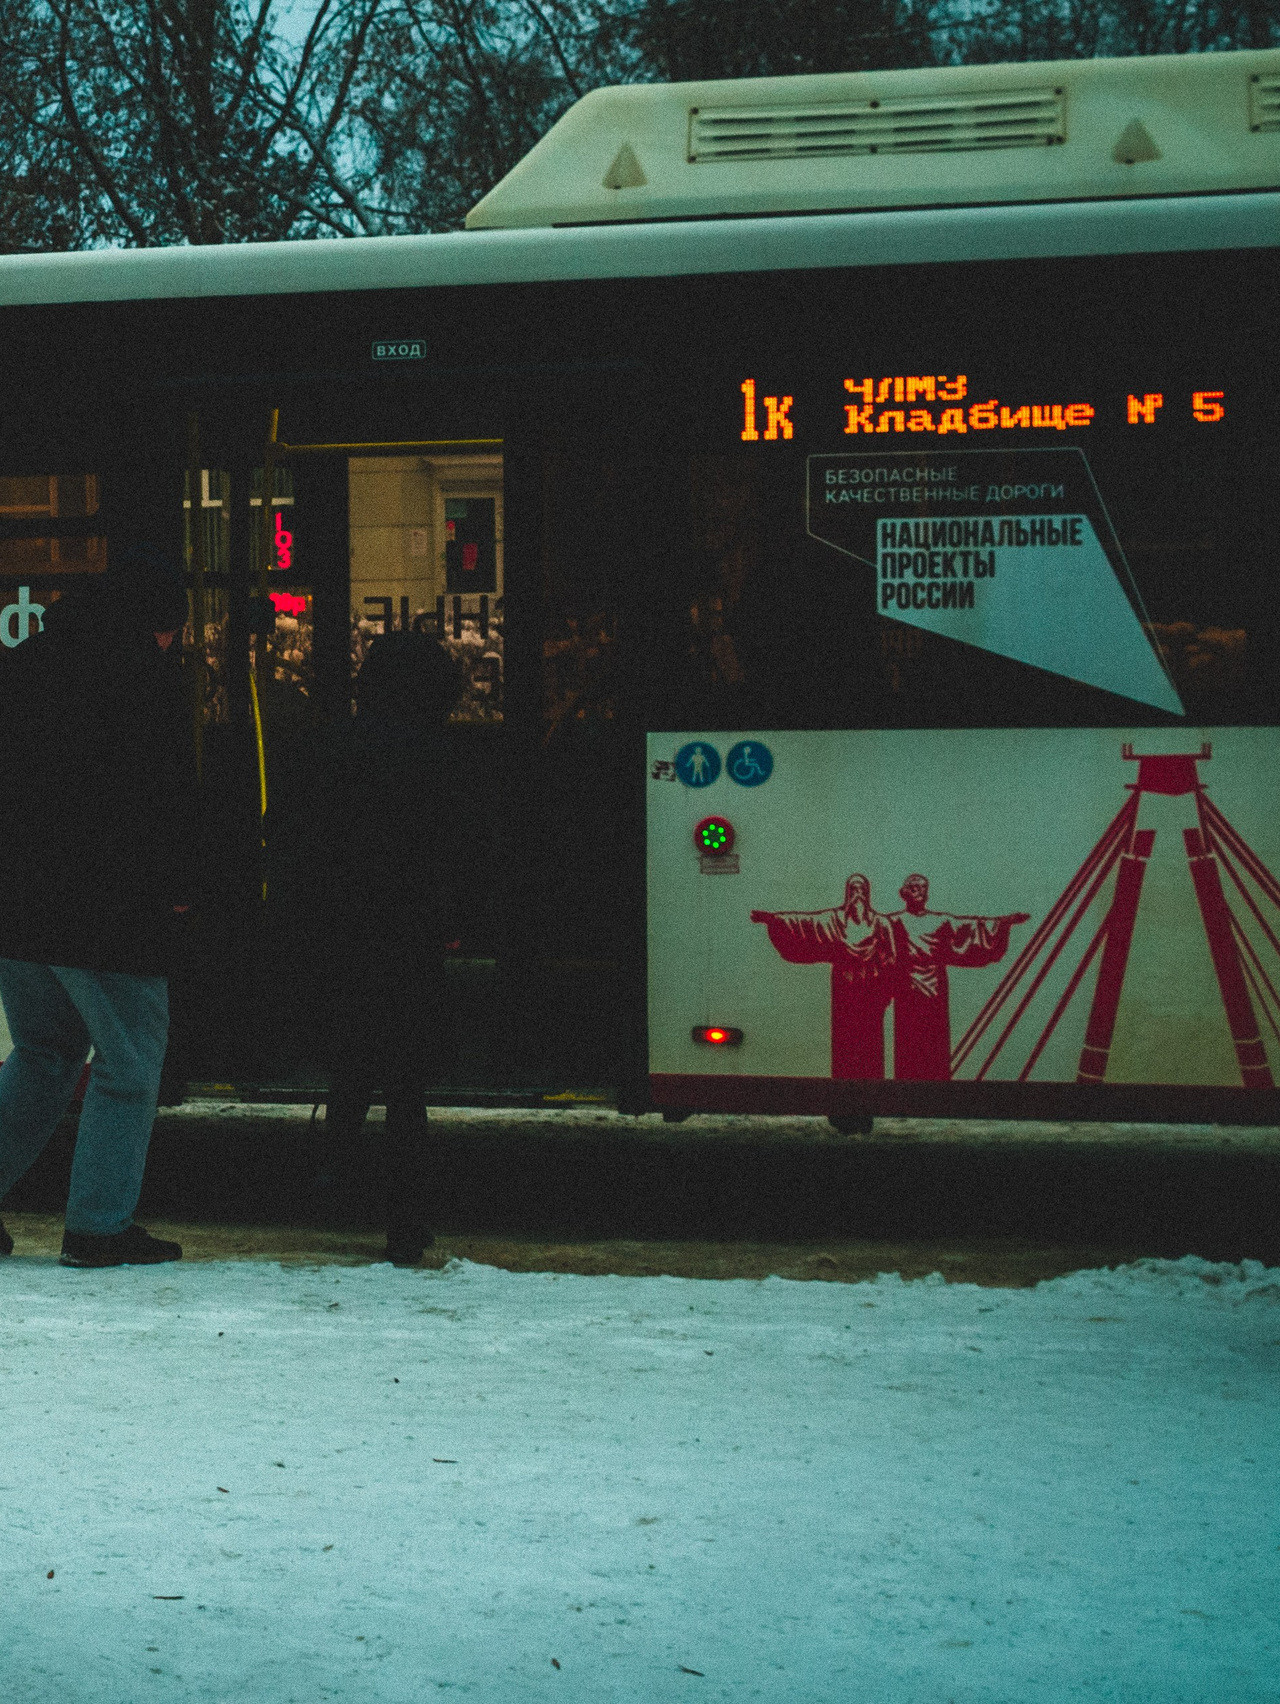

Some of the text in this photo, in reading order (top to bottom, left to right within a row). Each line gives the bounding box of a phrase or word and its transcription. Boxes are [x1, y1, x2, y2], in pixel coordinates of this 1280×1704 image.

[376, 344, 421, 358] ВХОД
[843, 375, 968, 403] ЧЛМЗ
[843, 399, 1095, 434] Кладбище
[1192, 391, 1224, 422] 5
[825, 465, 958, 485] БЕЗОПАСНЫЕ
[825, 482, 1064, 504] КАЧЕСТВЕННЫЕ ДОРОГИ
[880, 517, 1084, 550] НАЦИОНАЛЬНЫЕ
[880, 551, 996, 579] ПРОЕКТЫ
[880, 581, 975, 609] РОССИИ
